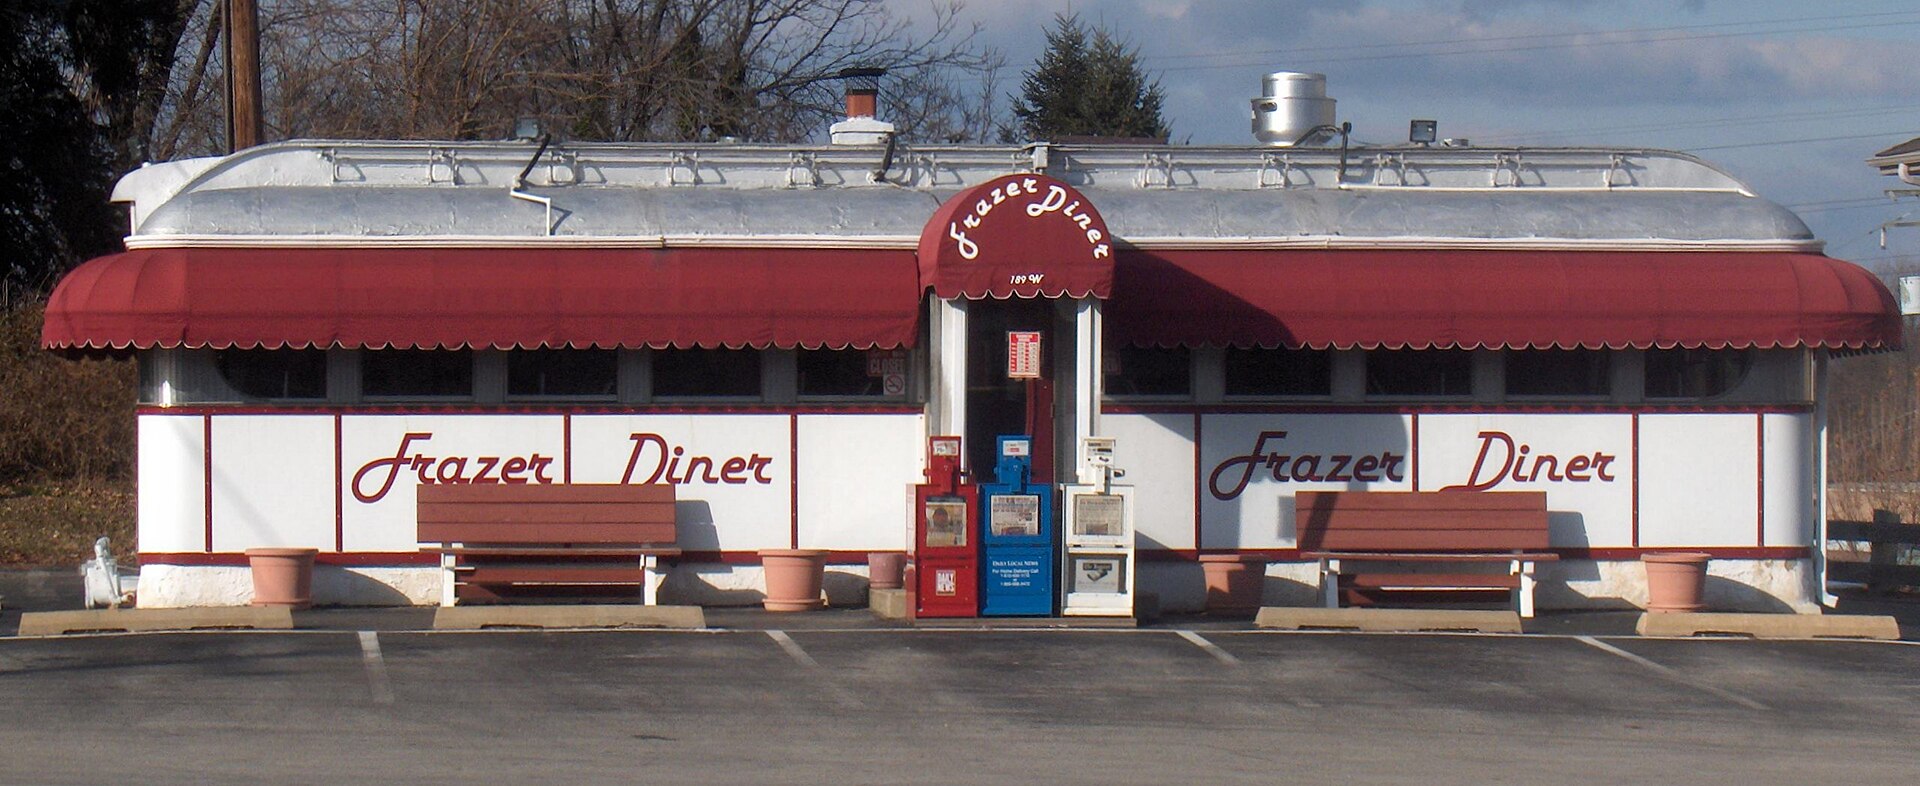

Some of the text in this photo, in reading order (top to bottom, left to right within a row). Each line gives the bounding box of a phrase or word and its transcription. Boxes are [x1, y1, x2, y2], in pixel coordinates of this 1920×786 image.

[949, 177, 1108, 259] Frazer Diner
[1010, 273, 1044, 285] 189 W
[351, 432, 772, 503] Frazer Diner
[1208, 430, 1615, 502] Frazer Diner
